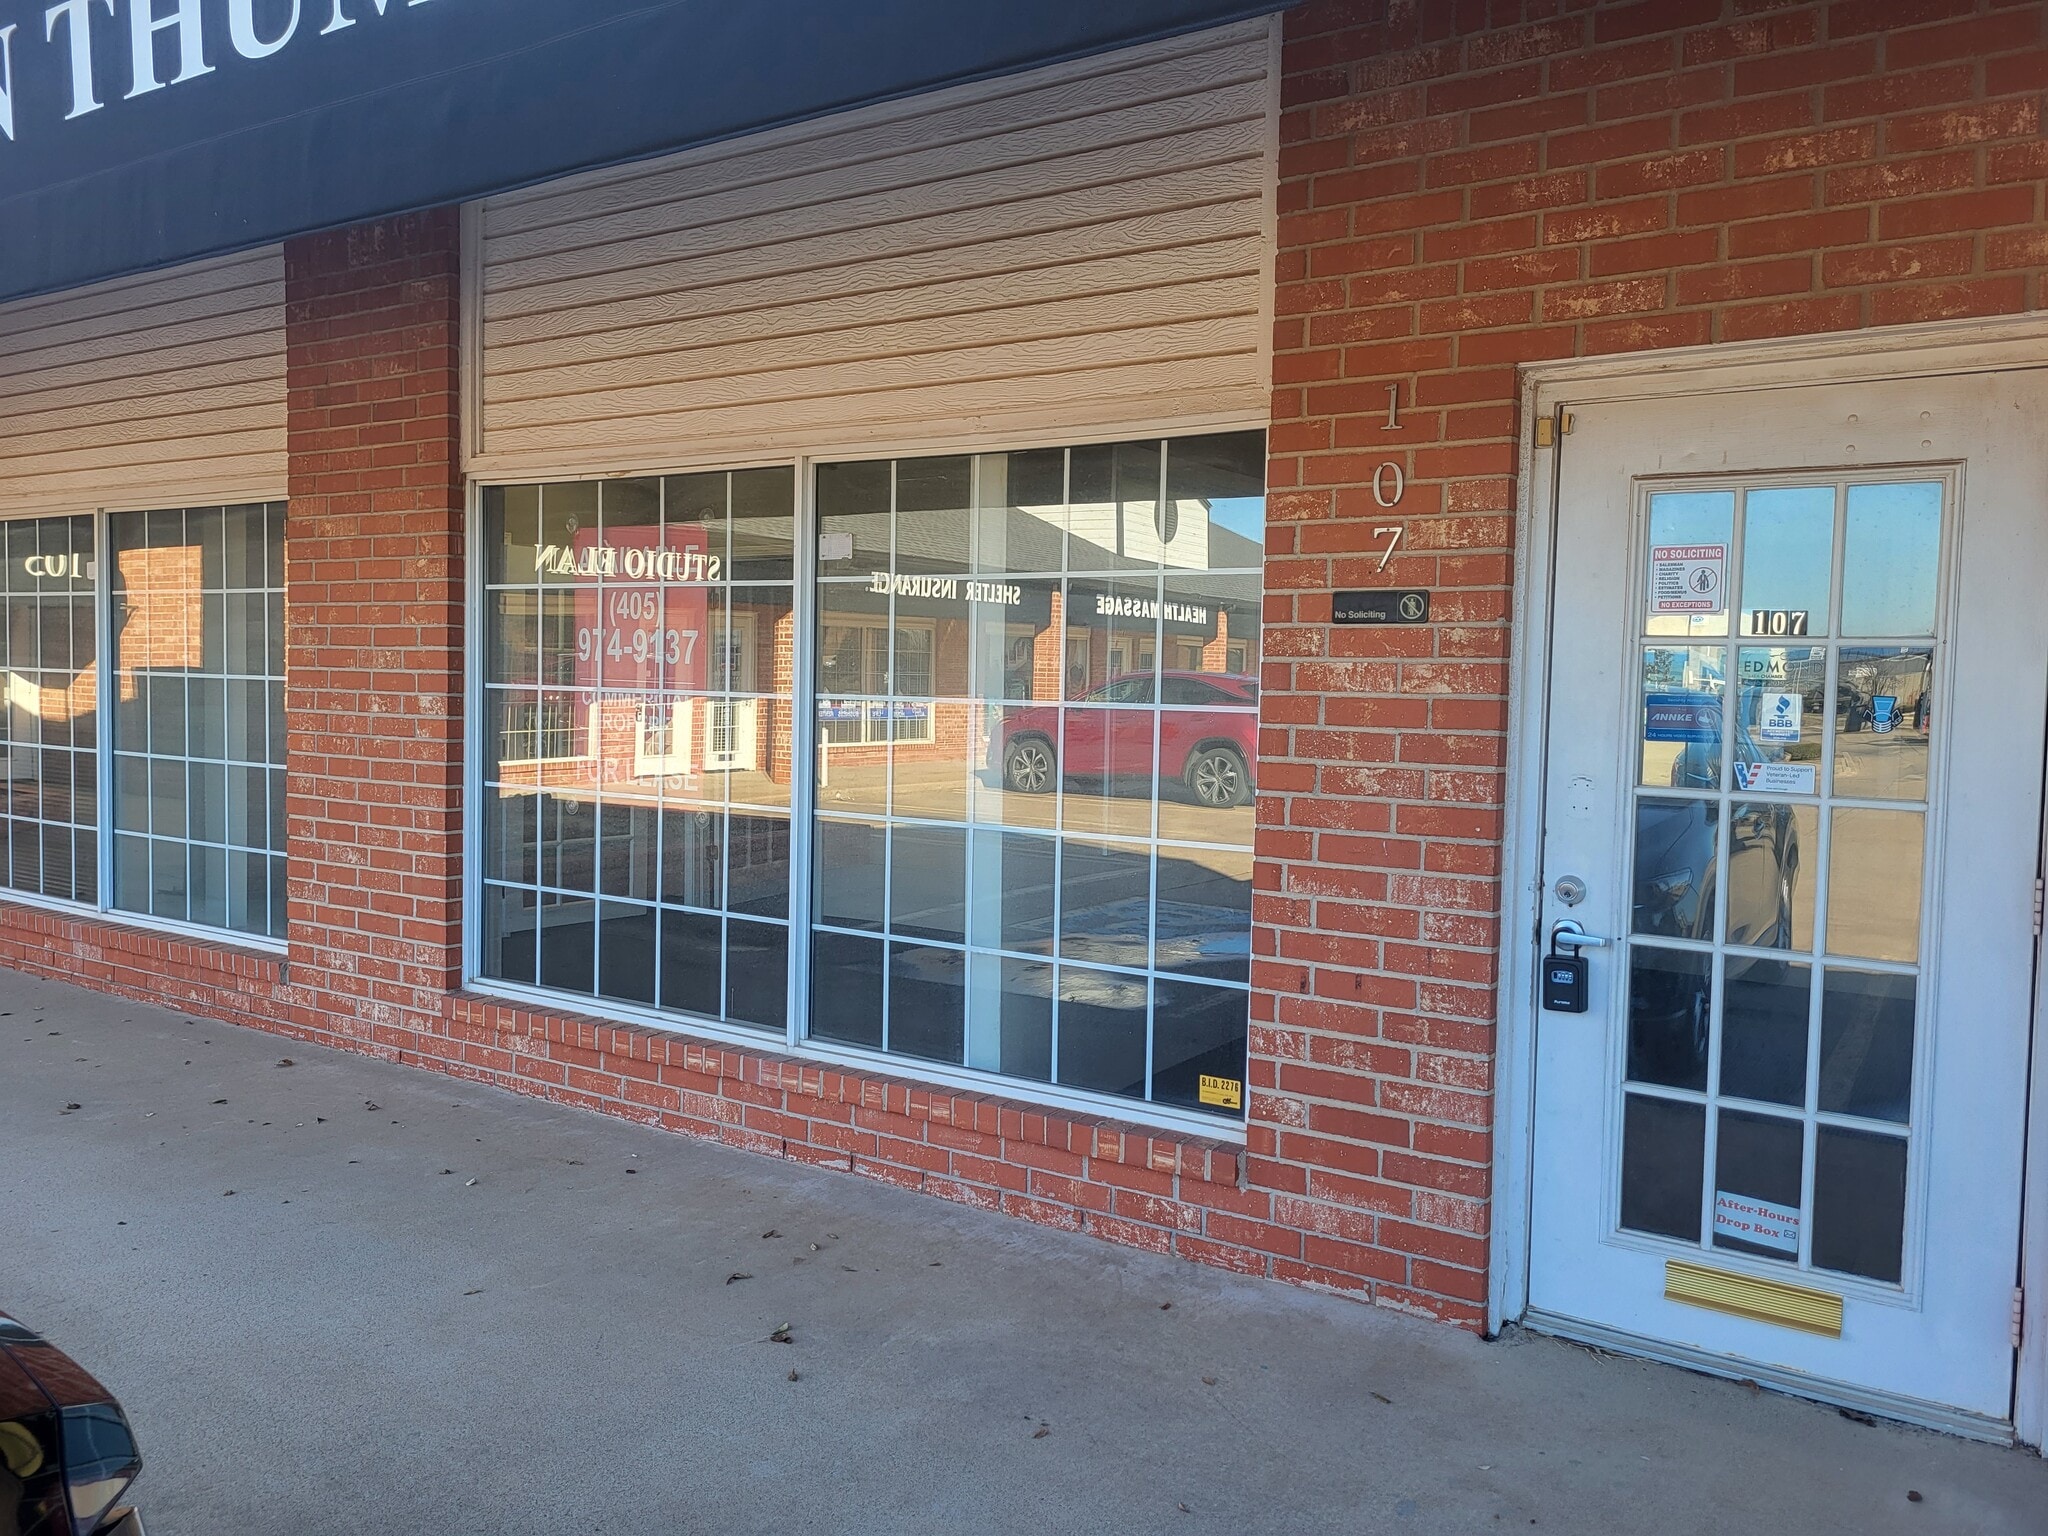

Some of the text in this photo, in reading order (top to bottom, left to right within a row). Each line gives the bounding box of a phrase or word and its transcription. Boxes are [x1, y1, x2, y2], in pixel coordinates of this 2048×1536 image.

[1654, 549, 1722, 559] NO SOLICITING
[609, 591, 661, 627] (405)
[1334, 610, 1386, 620] No Soliciting
[1755, 610, 1806, 635] 107
[578, 627, 699, 665] 974-9137
[1651, 713, 1693, 721] ANNKE
[1769, 719, 1793, 728] BBB
[1201, 1077, 1239, 1092] B.I.D. 2276
[1717, 1197, 1799, 1226] After-Hours
[1716, 1214, 1780, 1238] Drop Box
